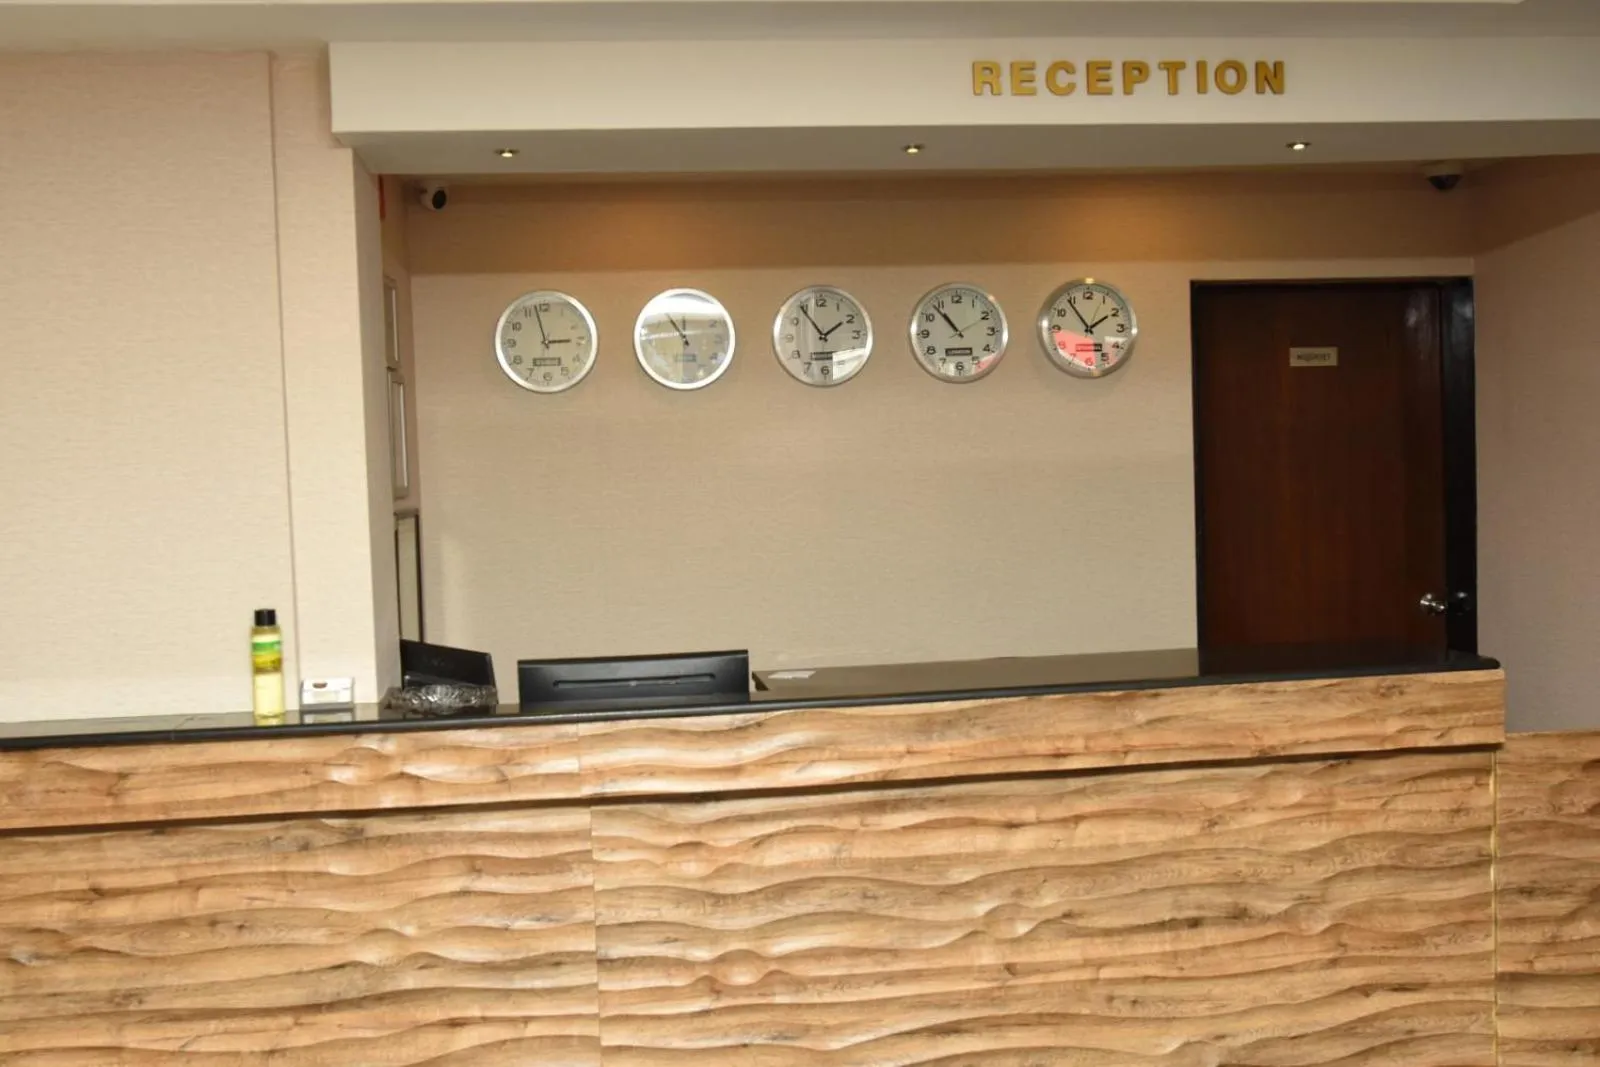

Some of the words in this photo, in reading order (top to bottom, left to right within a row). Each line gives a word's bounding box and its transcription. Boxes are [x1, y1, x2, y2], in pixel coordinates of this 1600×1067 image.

[972, 60, 1285, 95] RECEPTION
[951, 295, 962, 304] 12
[1083, 292, 1093, 300] 12
[539, 303, 550, 312] 12
[816, 299, 827, 307] 12
[938, 300, 944, 308] 11
[981, 311, 989, 320] 2
[1057, 309, 1066, 317] 10
[1111, 308, 1119, 316] 2
[846, 315, 855, 324] 2
[925, 314, 935, 322] 10
[512, 322, 521, 331] 10
[1052, 325, 1061, 333] 9
[1116, 324, 1124, 332] 3
[852, 330, 861, 339] 3
[921, 330, 929, 338] 9
[987, 327, 995, 336] 3
[507, 339, 516, 347] 9
[927, 346, 936, 355] 8
[513, 355, 522, 365] 8
[1101, 353, 1109, 361] 5
[821, 366, 829, 375] 6
[956, 362, 964, 371] 6
[543, 372, 552, 381] 6
